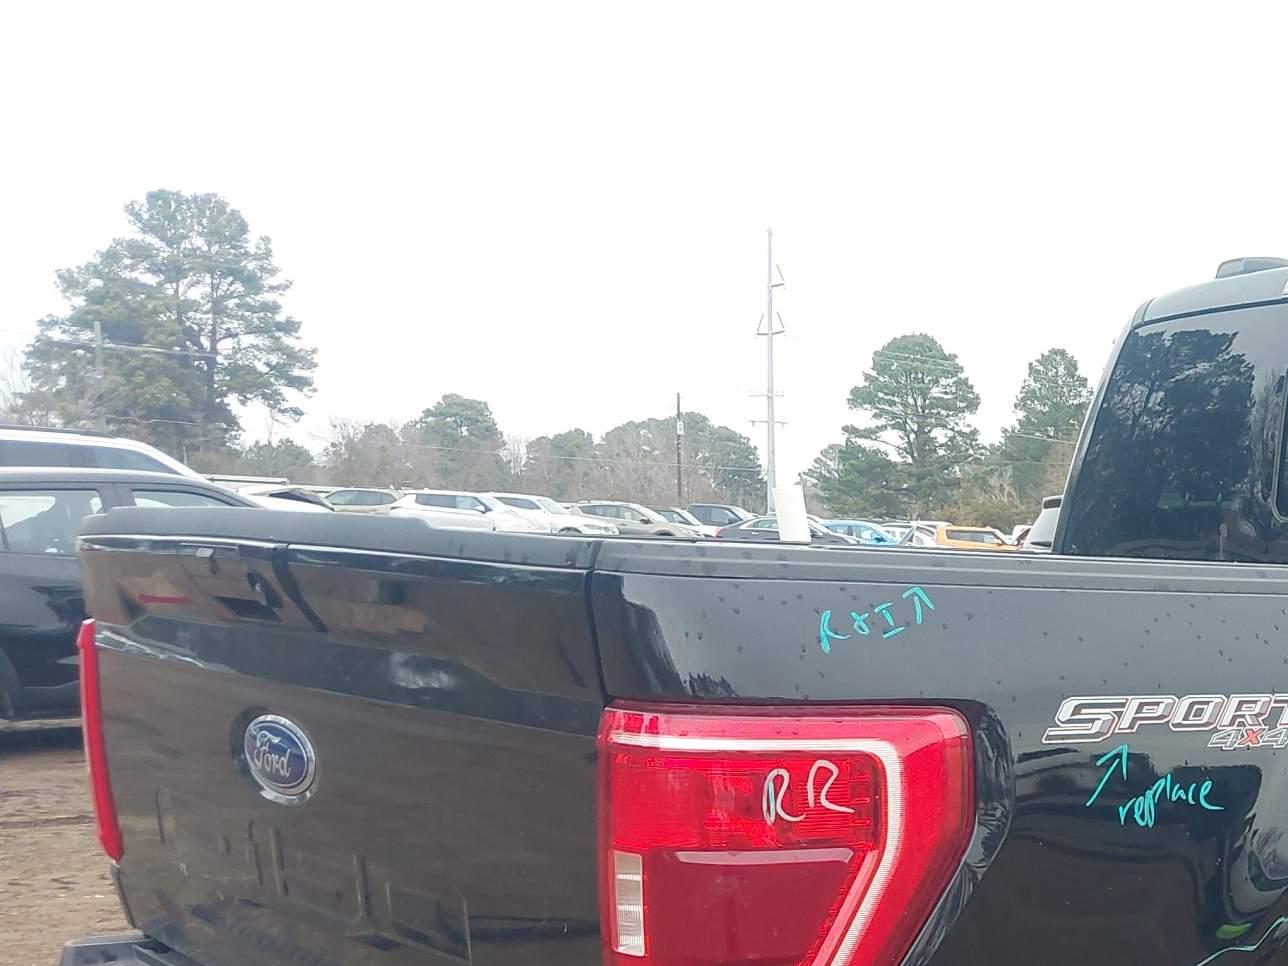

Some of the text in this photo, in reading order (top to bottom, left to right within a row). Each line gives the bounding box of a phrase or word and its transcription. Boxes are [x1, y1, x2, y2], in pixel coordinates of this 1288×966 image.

[254, 730, 292, 778] Ford
[762, 759, 856, 826] RR
[1118, 773, 1225, 828] replace
